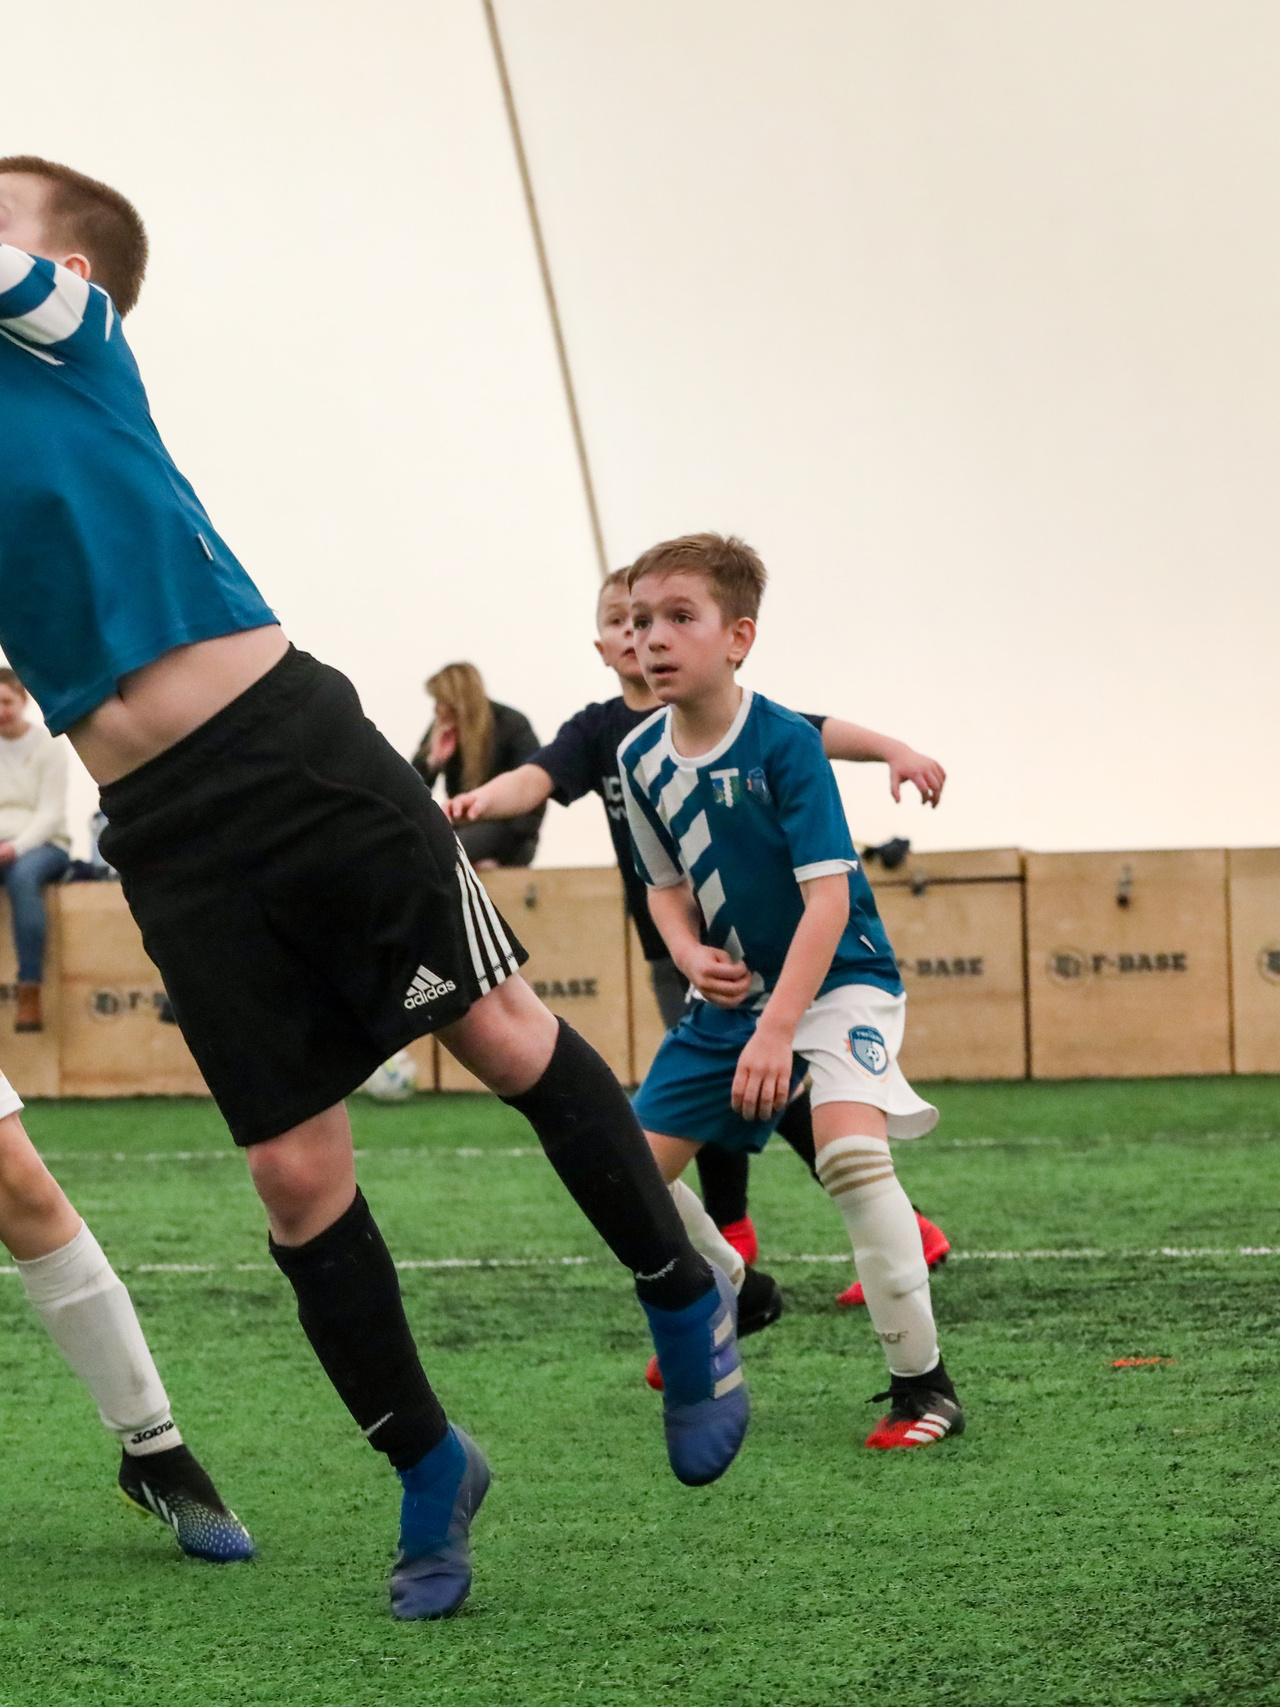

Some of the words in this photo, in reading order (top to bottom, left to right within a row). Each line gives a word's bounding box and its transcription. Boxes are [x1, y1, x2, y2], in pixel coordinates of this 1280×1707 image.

[896, 957, 983, 977] -BASE
[1091, 952, 1187, 974] F-BASE
[404, 980, 457, 1010] adidas
[131, 1420, 174, 1444] Joma
